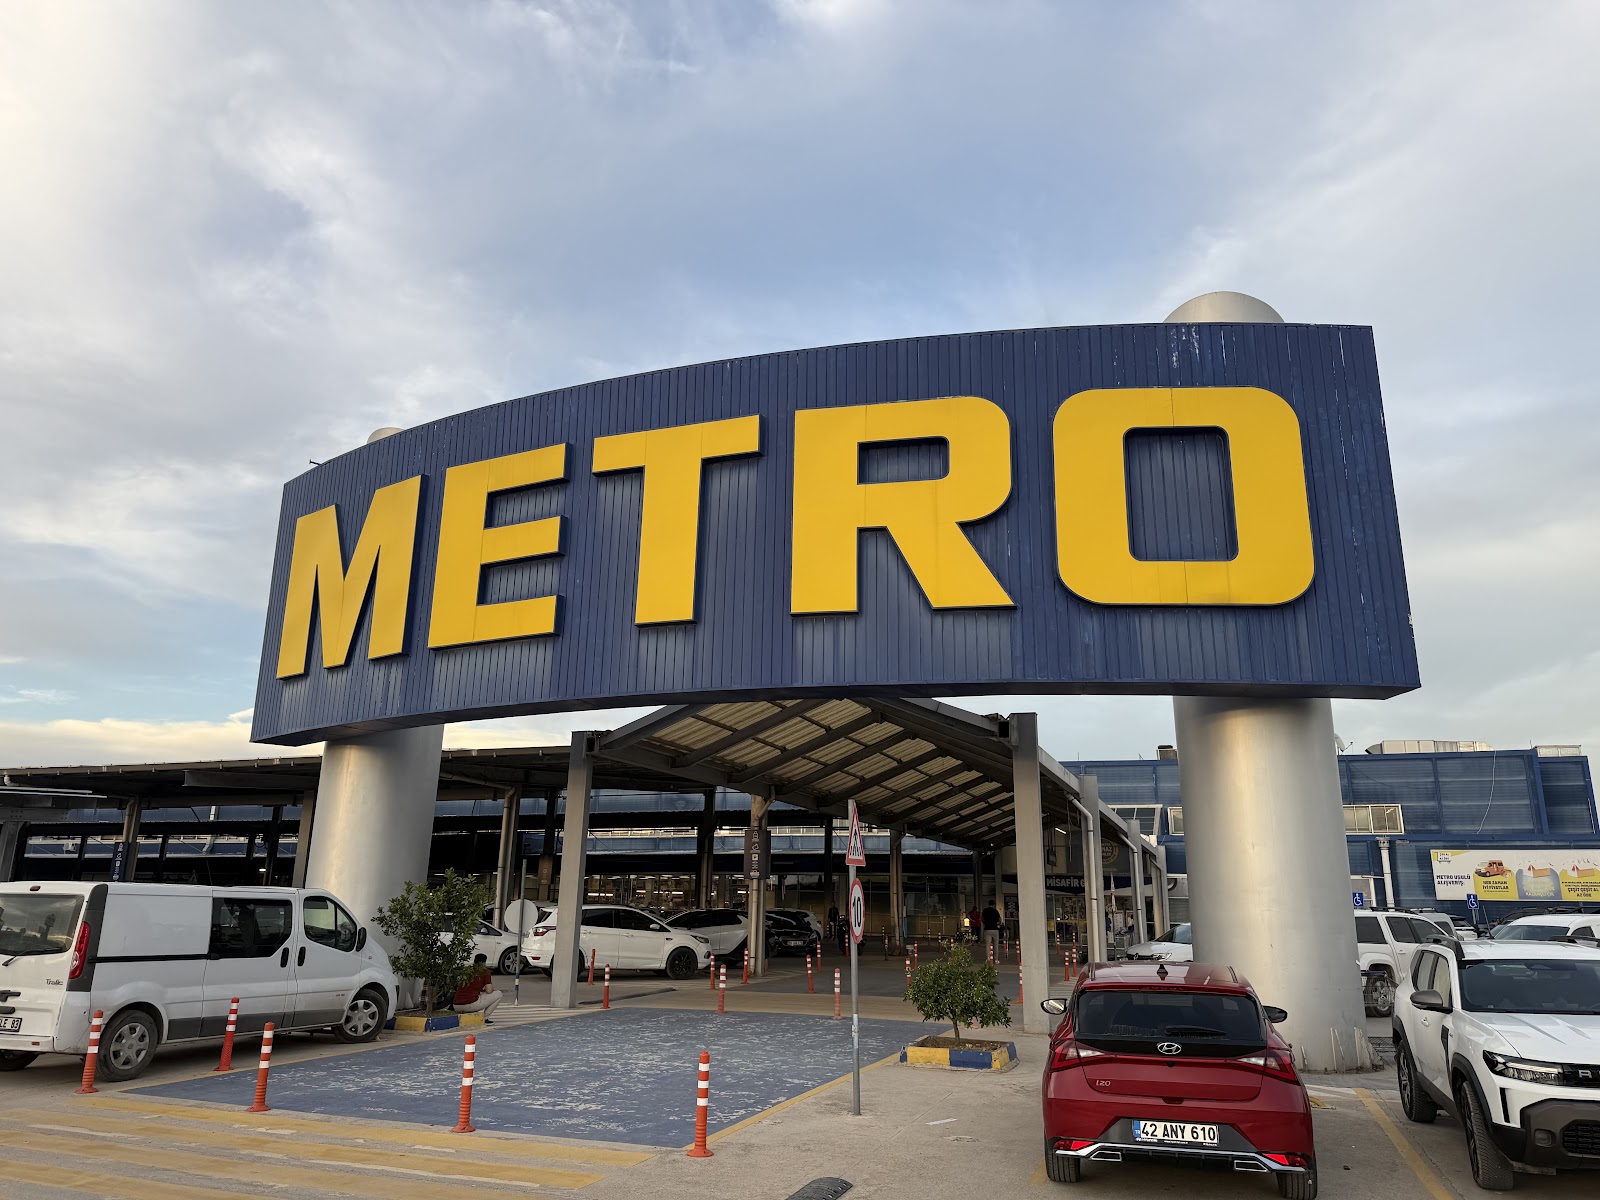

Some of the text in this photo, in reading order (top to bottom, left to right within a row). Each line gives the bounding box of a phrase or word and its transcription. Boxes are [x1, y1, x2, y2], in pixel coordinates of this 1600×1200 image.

[276, 386, 1316, 680] METRO
[1046, 876, 1080, 887] MİSAFİR
[852, 895, 861, 927] 10
[1141, 1122, 1158, 1137] 42
[1162, 1123, 1186, 1139] ANY
[1190, 1126, 1216, 1141] 610
